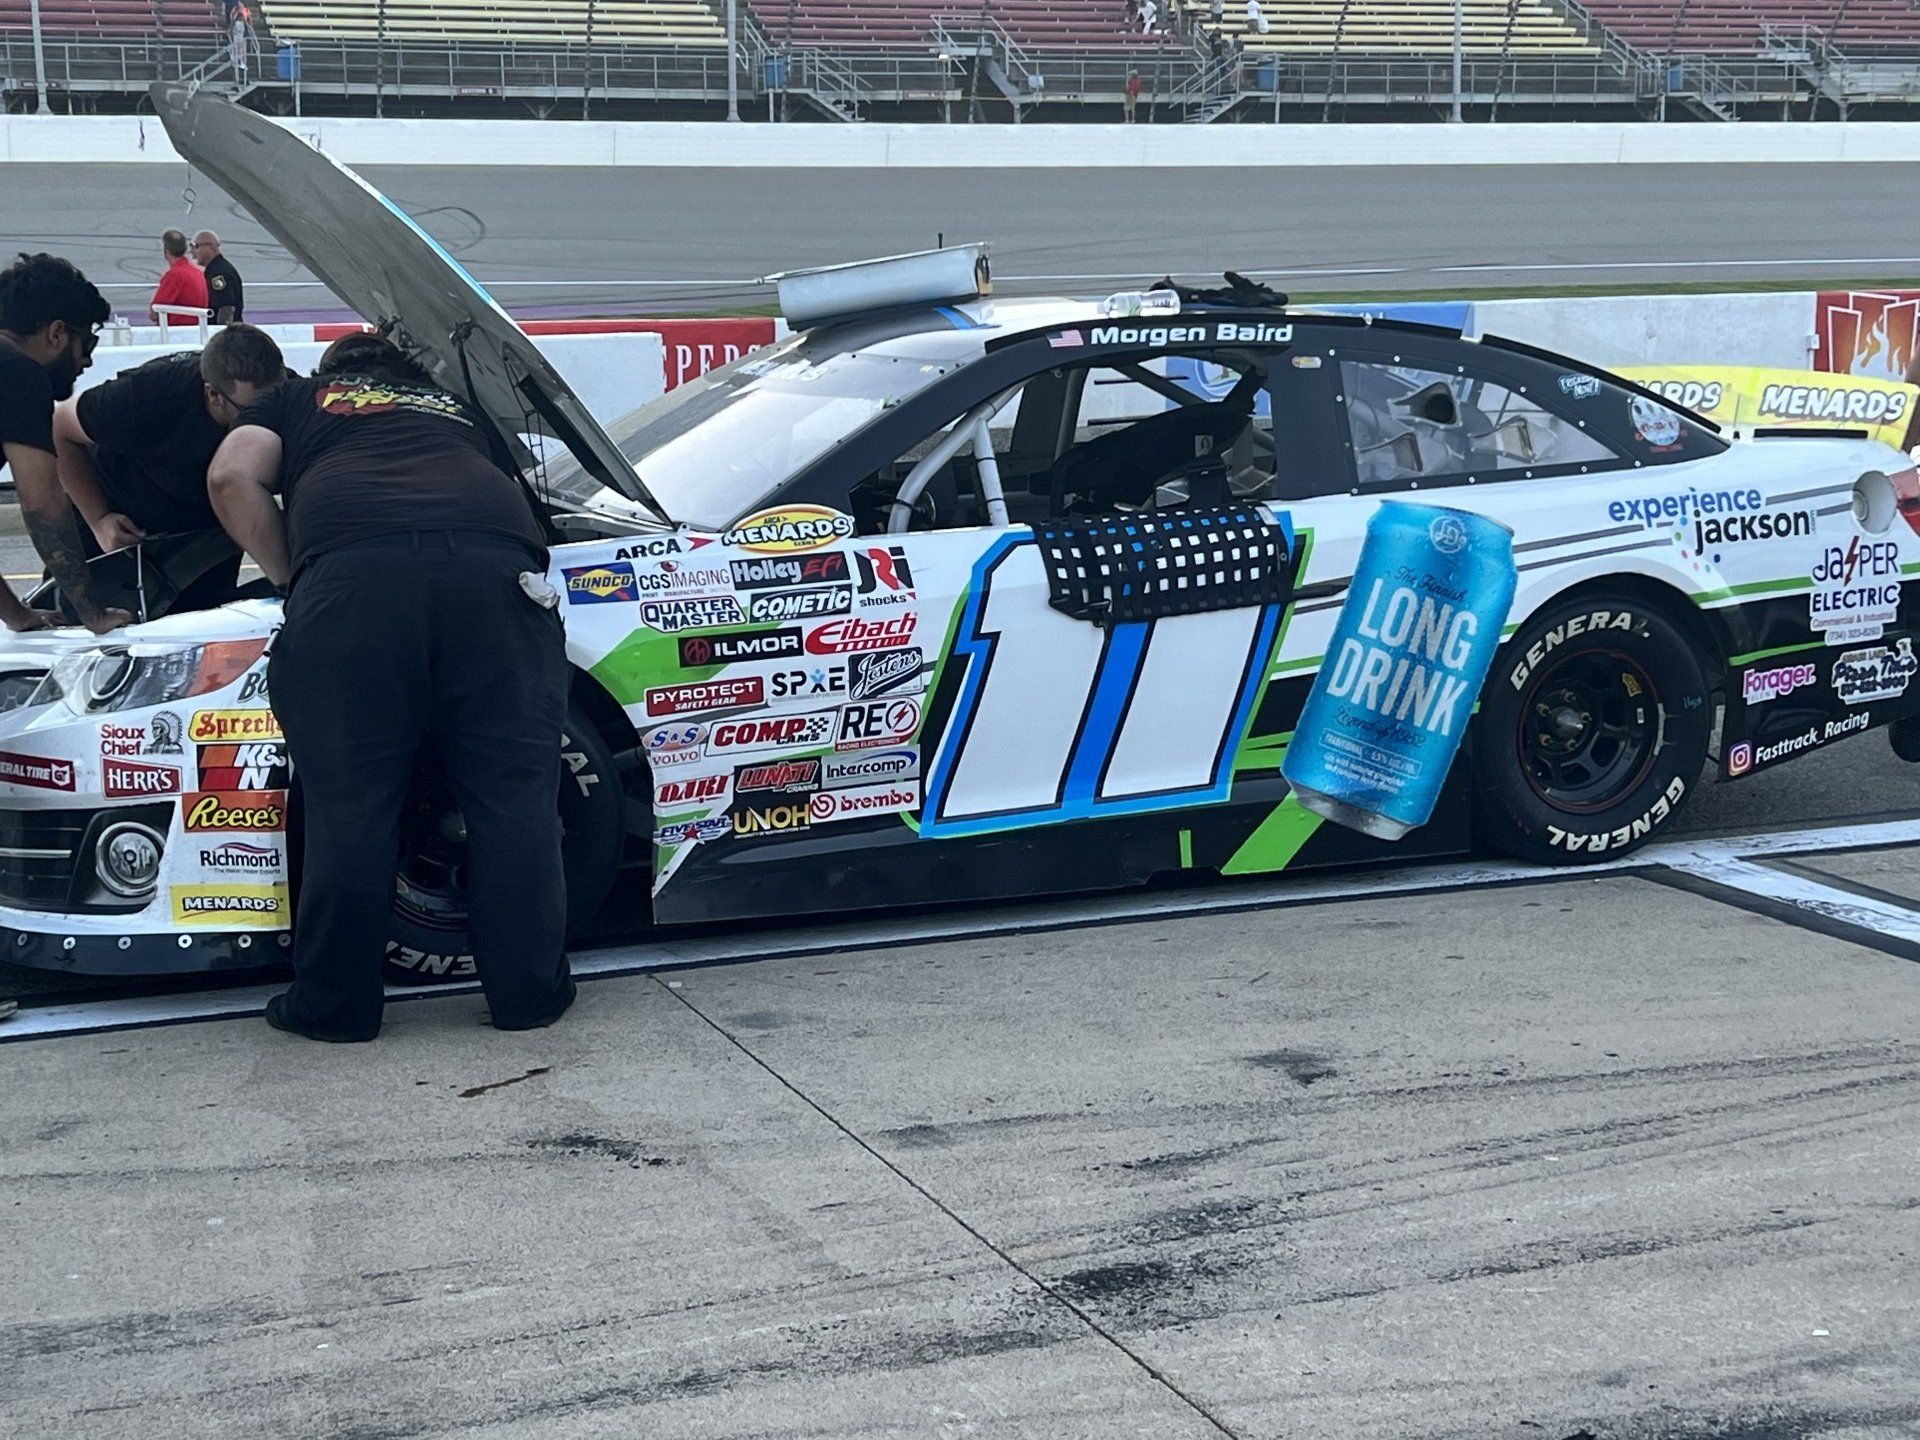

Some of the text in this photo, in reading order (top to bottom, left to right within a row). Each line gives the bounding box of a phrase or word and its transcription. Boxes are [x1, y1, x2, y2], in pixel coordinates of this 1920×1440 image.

[1091, 323, 1294, 347] Morgen Baird
[1760, 385, 1906, 423] MENARDS
[1608, 487, 1762, 527] experience
[723, 517, 850, 546] MENARDS
[1694, 509, 1810, 556] jackson
[616, 539, 682, 560] ARCA
[570, 573, 634, 590] SUNOCO
[731, 554, 842, 583] Holley EFI
[644, 599, 734, 623] QUARTER
[752, 585, 850, 618] COMETIC
[860, 594, 907, 608] shocks
[1812, 585, 1898, 612] ELECTRIC
[662, 610, 741, 630] MASTER
[1357, 578, 1478, 671] LONG
[714, 636, 800, 656] ILMOR
[805, 613, 917, 655] Eibach
[1510, 611, 1650, 690] GENERA
[851, 651, 921, 699] Jostens
[1327, 638, 1468, 737] DRINK
[1745, 666, 1813, 695] Forager
[653, 681, 757, 705] PYROTECT
[675, 697, 737, 711] SAFETY GEAR
[101, 724, 146, 740] Sioux
[195, 710, 283, 739] Sprech
[714, 718, 806, 747] COMP
[1755, 711, 1870, 764] Fasttrack_Racing
[101, 740, 141, 755] Chief
[776, 732, 819, 745] CAMS
[0, 760, 51, 781] ERAL TIRE
[653, 751, 698, 765] VOLVO
[827, 756, 907, 779] Intercomp
[108, 766, 173, 790] HERR'S
[737, 761, 817, 790] LUNATI
[187, 796, 282, 828] Reese's
[841, 790, 914, 812] brembo
[1547, 776, 1686, 852] GENERAL
[734, 804, 810, 834] UNOH
[200, 847, 280, 867] Richmond
[183, 896, 279, 911] MENARDS
